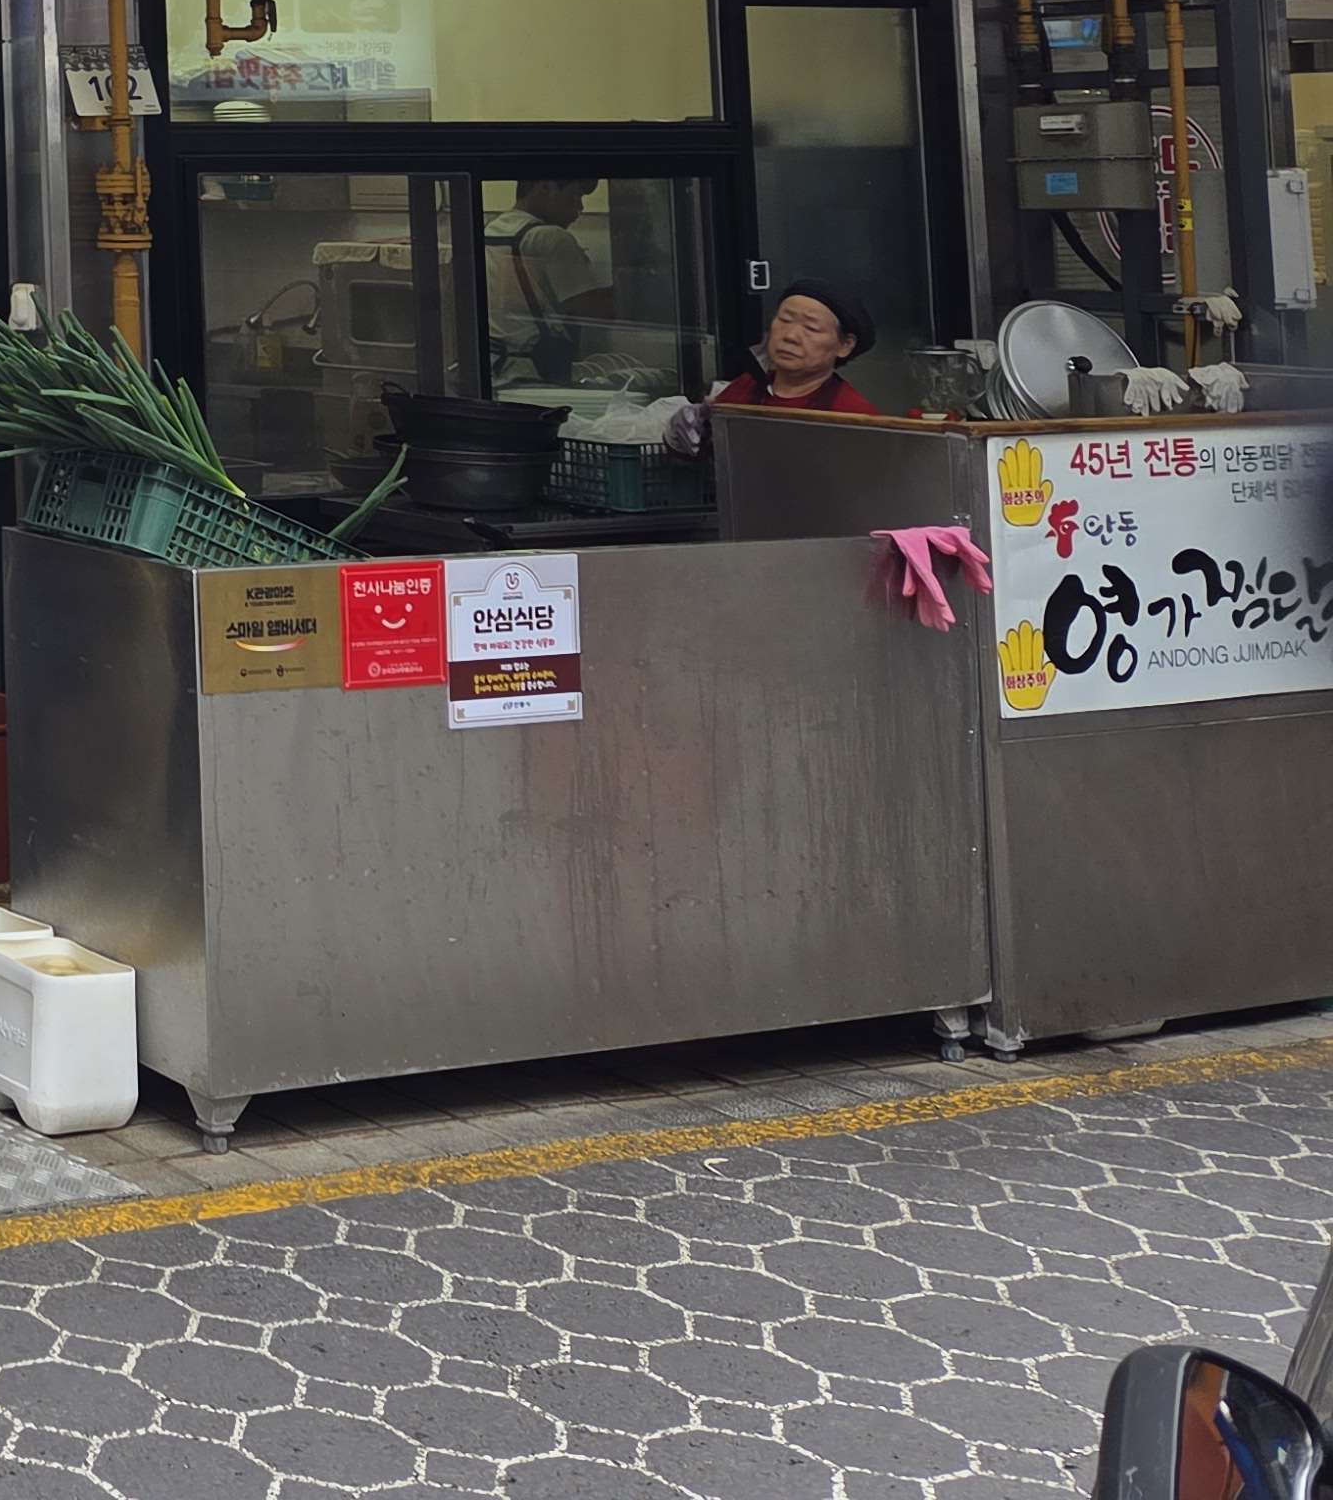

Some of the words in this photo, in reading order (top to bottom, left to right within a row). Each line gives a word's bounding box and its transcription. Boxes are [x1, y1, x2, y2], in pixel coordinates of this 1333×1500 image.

[1070, 439, 1134, 479] 45년
[1143, 436, 1218, 478] 전통의
[1223, 442, 1296, 473] 안동찜닭
[1002, 489, 1045, 506] 화상주의
[1083, 511, 1139, 547] 안동
[246, 586, 295, 600] K관광마켓
[353, 578, 432, 598] 천사나눔인증
[473, 604, 555, 634] 안심식당
[225, 620, 265, 640] 스마일
[1147, 645, 1229, 670] ANDONG
[1233, 639, 1308, 663] JJIMDAK
[1005, 671, 1047, 689] 화상주의
